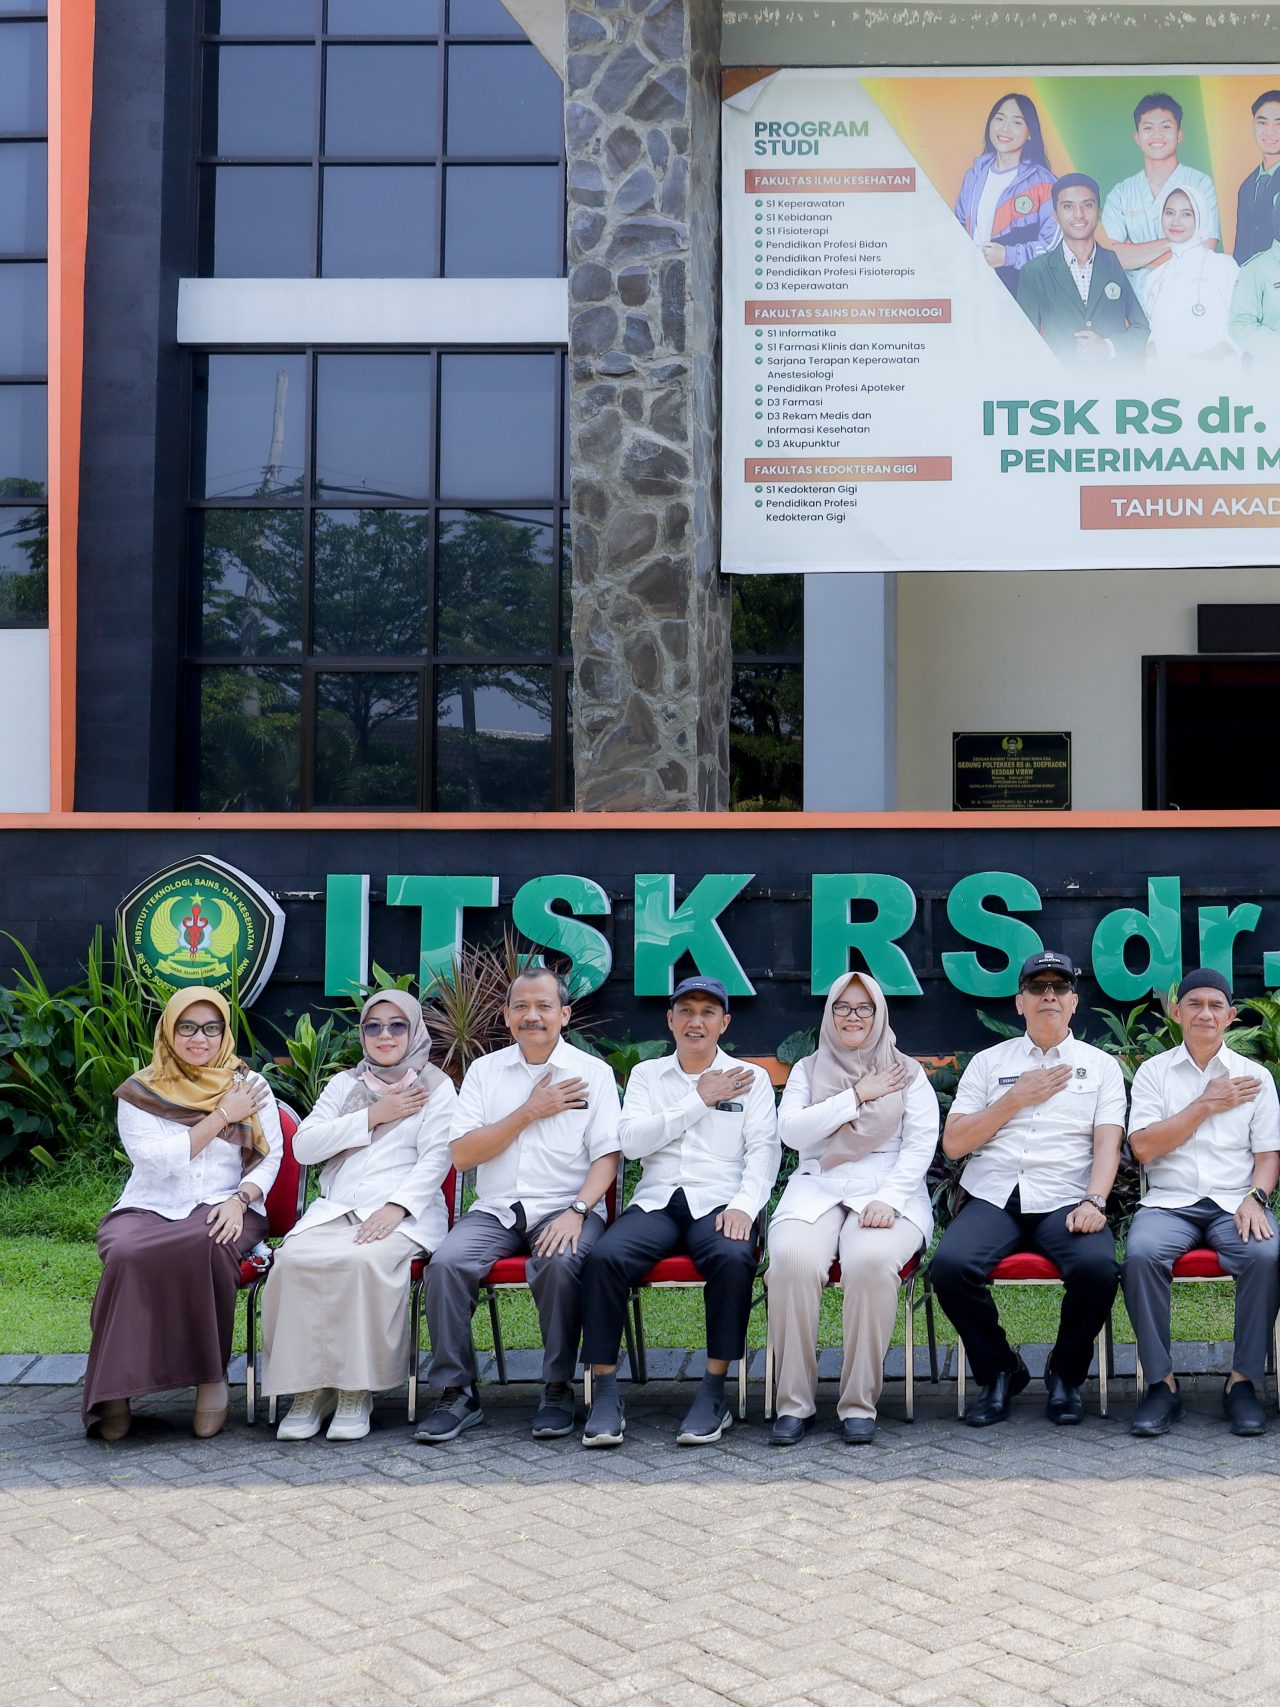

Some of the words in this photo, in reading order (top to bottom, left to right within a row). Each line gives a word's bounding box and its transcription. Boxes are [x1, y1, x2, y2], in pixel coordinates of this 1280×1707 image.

[755, 121, 869, 137] PROGRAM
[755, 140, 819, 156] STUDI
[755, 176, 812, 185] FAKULTAS
[815, 176, 841, 185] ILMU
[844, 176, 910, 185] KESEHATAN
[767, 200, 775, 208] S1
[778, 200, 845, 210] Keperawatan
[778, 213, 832, 221] Kebidanan
[766, 227, 775, 235] S1
[778, 227, 829, 237] Fisioterapi
[766, 241, 821, 249] Pendidikan
[824, 240, 857, 248] Profesi
[859, 240, 888, 248] Bidan
[766, 254, 821, 262] Pendidikan
[824, 254, 857, 262] Profesi
[859, 254, 881, 262] Ners
[766, 268, 821, 276] Pendidikan
[824, 268, 857, 276] Profesi
[859, 268, 915, 278] Fisioterapis
[767, 282, 779, 290] D3
[782, 282, 848, 292] Keperawatan
[755, 309, 812, 318] FAKULTAS
[815, 309, 848, 318] SAINS
[851, 309, 875, 317] DAN
[878, 308, 942, 317] TEKNOLOGI
[779, 329, 836, 337] Informatika
[768, 343, 776, 351] S1
[779, 343, 819, 351] Farmasi
[822, 343, 847, 351] Klinis
[850, 343, 869, 351] dan
[872, 342, 925, 350] Komunitas
[768, 357, 806, 367] Sarjana
[809, 357, 850, 367] Terapan
[853, 357, 920, 366] Keperawatan
[768, 370, 834, 381] Anestesiologi
[768, 384, 823, 392] Pendidikan
[825, 384, 858, 392] Profesi
[861, 384, 905, 394] Apoteker
[768, 398, 780, 406] D3
[783, 398, 823, 406] Farmasi
[768, 412, 780, 420] D3
[783, 412, 818, 420] Rekam
[820, 412, 849, 420] Medis
[983, 400, 1100, 436] ITSK
[1116, 398, 1183, 434] RS
[1198, 396, 1266, 434] dr.
[768, 426, 814, 434] Informasi
[817, 426, 870, 434] Kesehatan
[768, 440, 780, 448] D3
[783, 440, 840, 450] Akupunktur
[1001, 447, 1245, 473] PENERIMAAN
[755, 466, 812, 475] FAKULTAS
[815, 465, 891, 474] KEDOKTERAN
[893, 465, 917, 473] GIGI
[766, 486, 775, 494] S1
[778, 485, 835, 494] Kedokteran
[838, 485, 857, 496] Gigi
[767, 499, 822, 508] Pendidikan
[825, 499, 857, 507] Profesi
[1111, 498, 1203, 517] TAHUN
[826, 513, 846, 523] Gigi
[135, 907, 149, 944] INSTITUT
[146, 878, 193, 908] TEKNOLOGI,
[195, 878, 221, 892] SAINS,
[222, 887, 239, 903] DAN
[237, 900, 255, 951] KESEHATAN
[325, 874, 757, 997] ITSK
[811, 871, 1043, 996] RS
